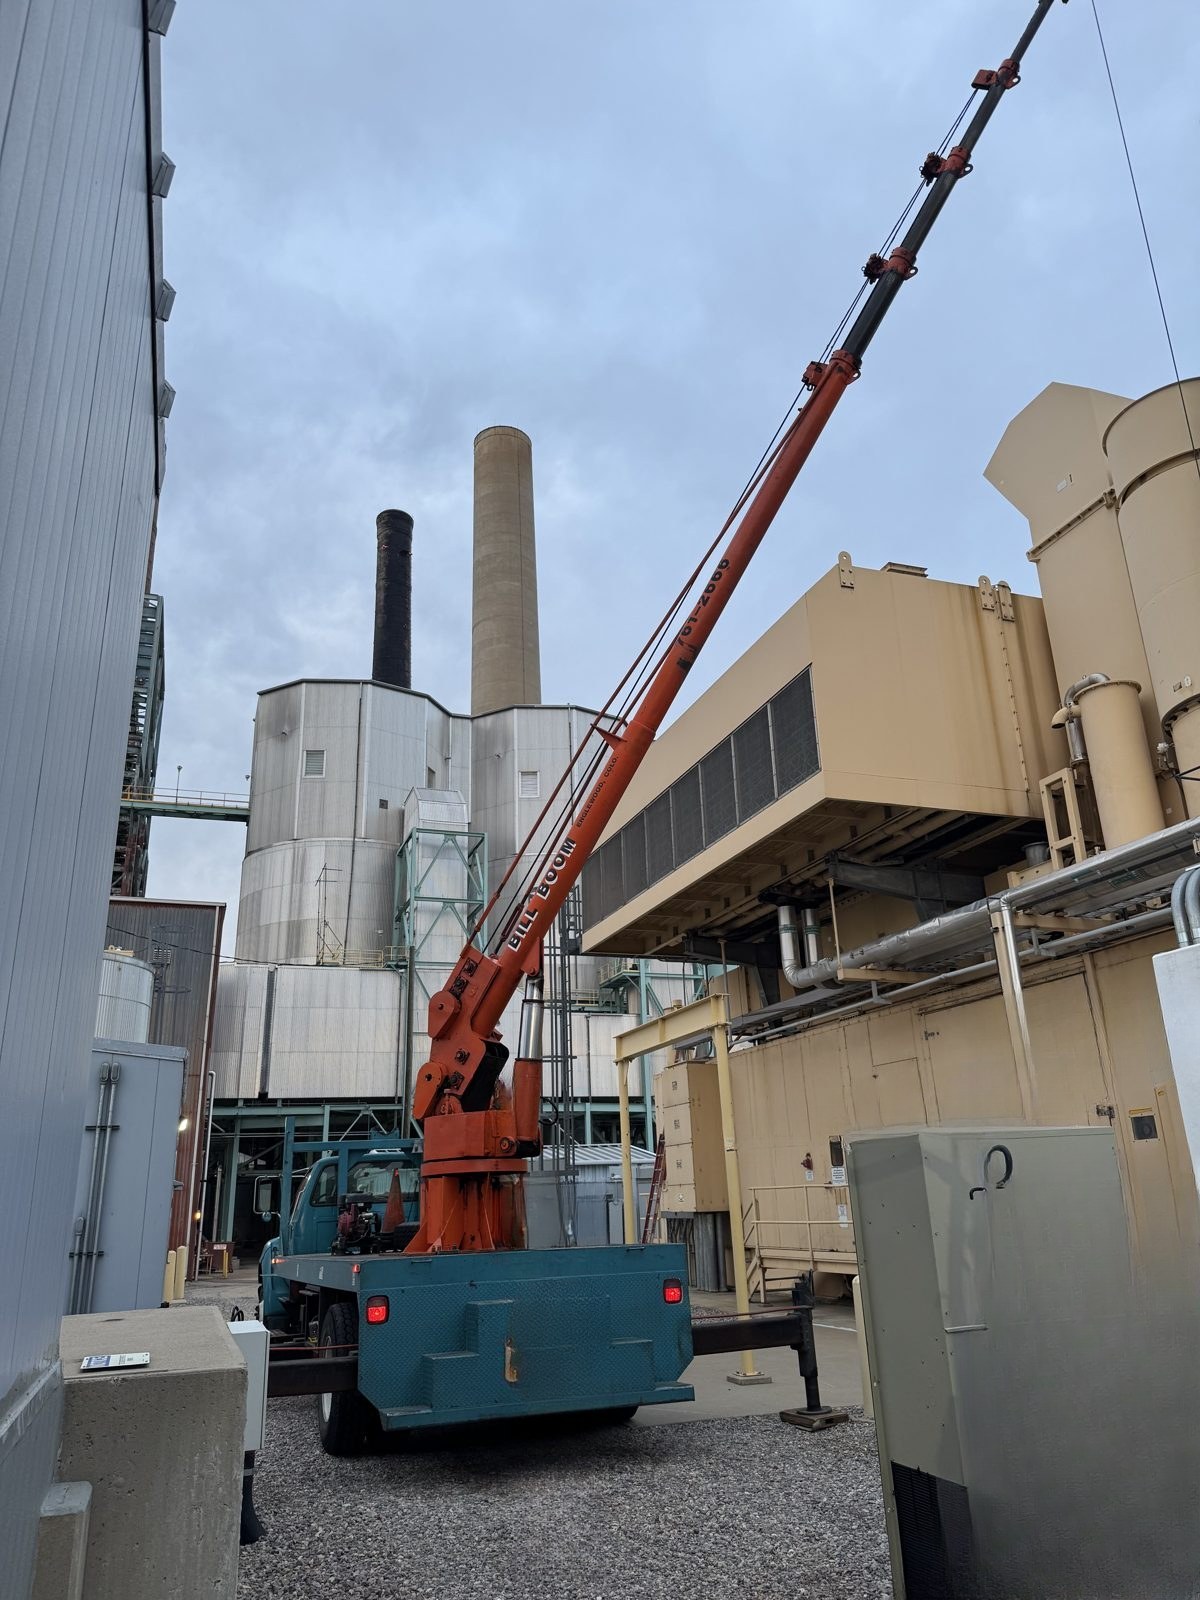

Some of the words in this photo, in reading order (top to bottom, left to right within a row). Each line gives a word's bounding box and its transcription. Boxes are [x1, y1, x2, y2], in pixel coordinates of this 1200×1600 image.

[603, 755, 619, 778] COLO.
[507, 907, 539, 952] BILL
[536, 837, 577, 900] BOOM
